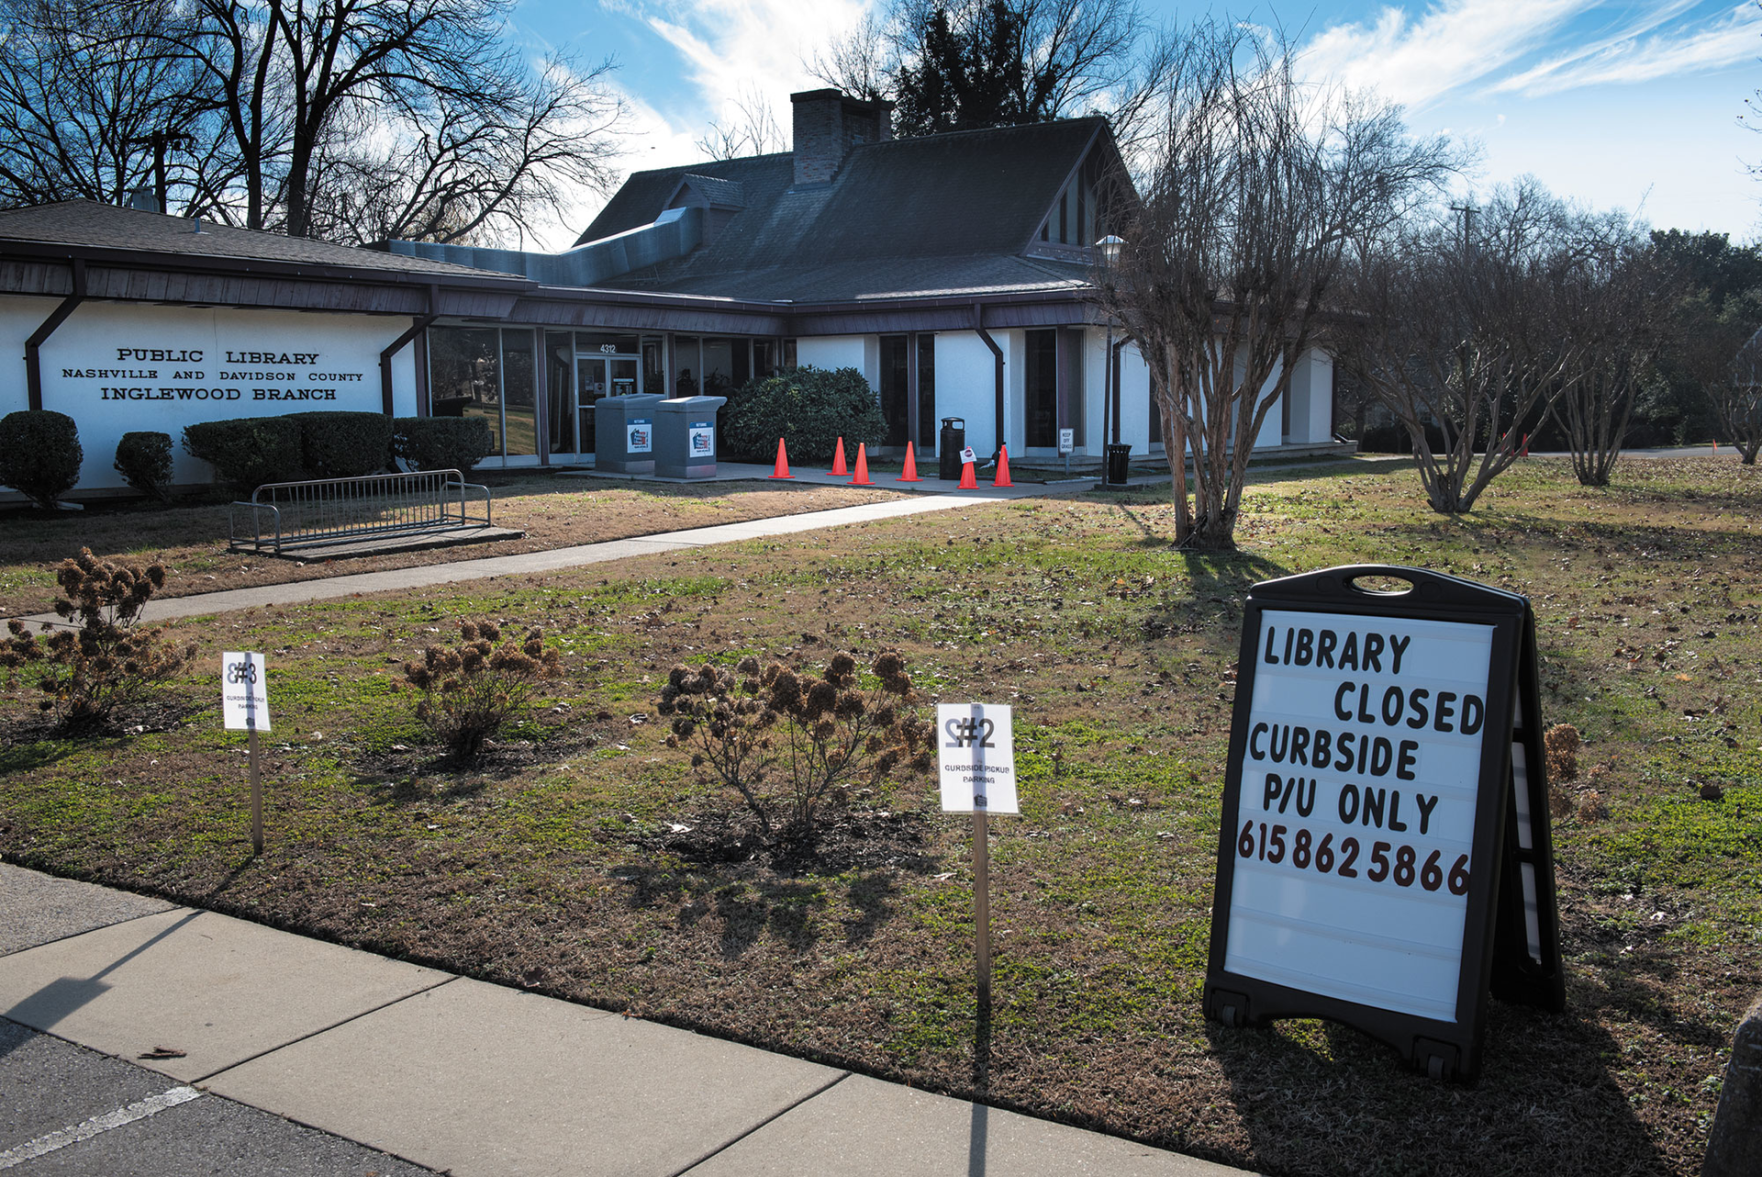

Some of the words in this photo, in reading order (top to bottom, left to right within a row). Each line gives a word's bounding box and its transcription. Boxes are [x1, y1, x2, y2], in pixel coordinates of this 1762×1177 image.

[117, 348, 203, 362] PUBLIC
[226, 351, 319, 364] LIBRARY
[600, 344, 616, 354] 4312
[62, 369, 158, 379] NASHVILLE
[173, 371, 205, 379] AND
[219, 371, 296, 381] DAVIDSON
[308, 373, 363, 381] COUNTY
[100, 387, 241, 400] INGLEWOOD
[252, 389, 336, 400] BRANCH
[1264, 625, 1411, 675] LIBRARY
[1334, 681, 1485, 735] CLOSED
[1250, 722, 1419, 781] CURBSIDE
[984, 765, 1010, 774] PICKUP
[962, 776, 996, 784] PARKING
[1263, 773, 1317, 817] P/U
[1338, 783, 1439, 835] ONLY
